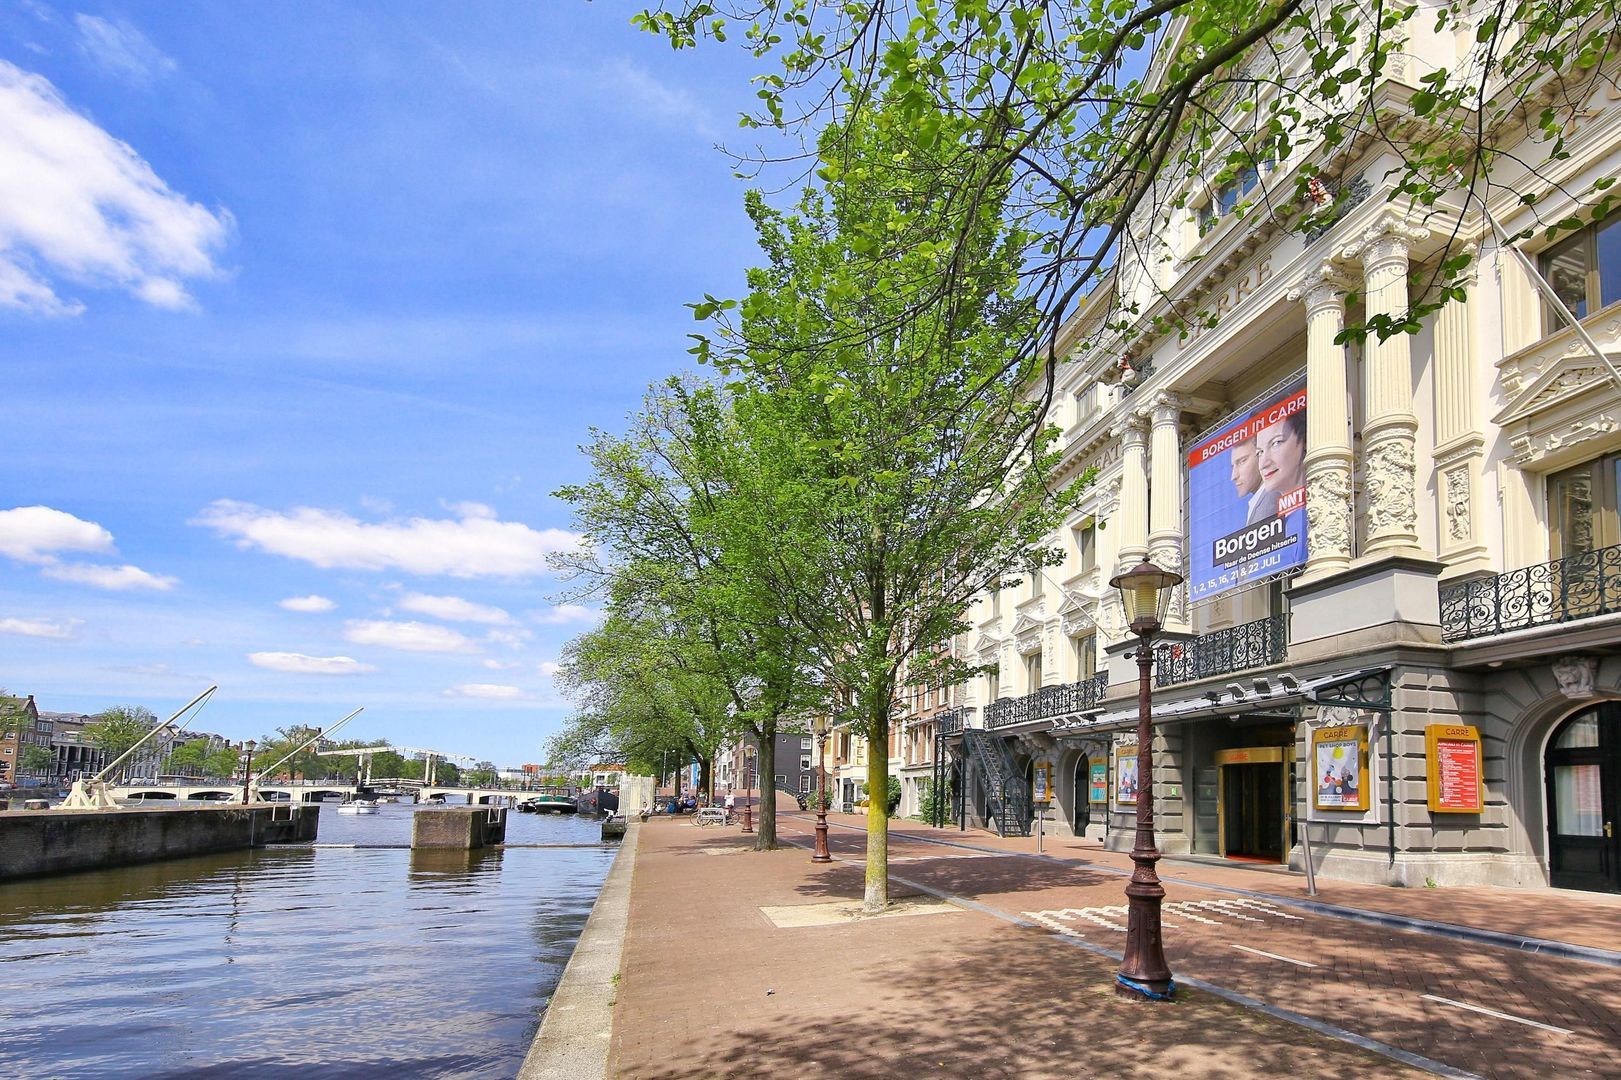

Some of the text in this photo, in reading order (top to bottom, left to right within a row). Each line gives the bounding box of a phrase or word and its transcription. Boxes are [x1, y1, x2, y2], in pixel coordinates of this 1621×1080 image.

[1202, 395, 1306, 460] BORGEN IN CARR
[1278, 487, 1305, 512] NNT
[1215, 517, 1283, 560] Borgen
[1224, 536, 1297, 570] Naar de Deense hitserie
[1230, 569, 1239, 580] 21
[1240, 568, 1247, 577] &
[1248, 563, 1259, 575] 22
[1260, 554, 1281, 570] JULI
